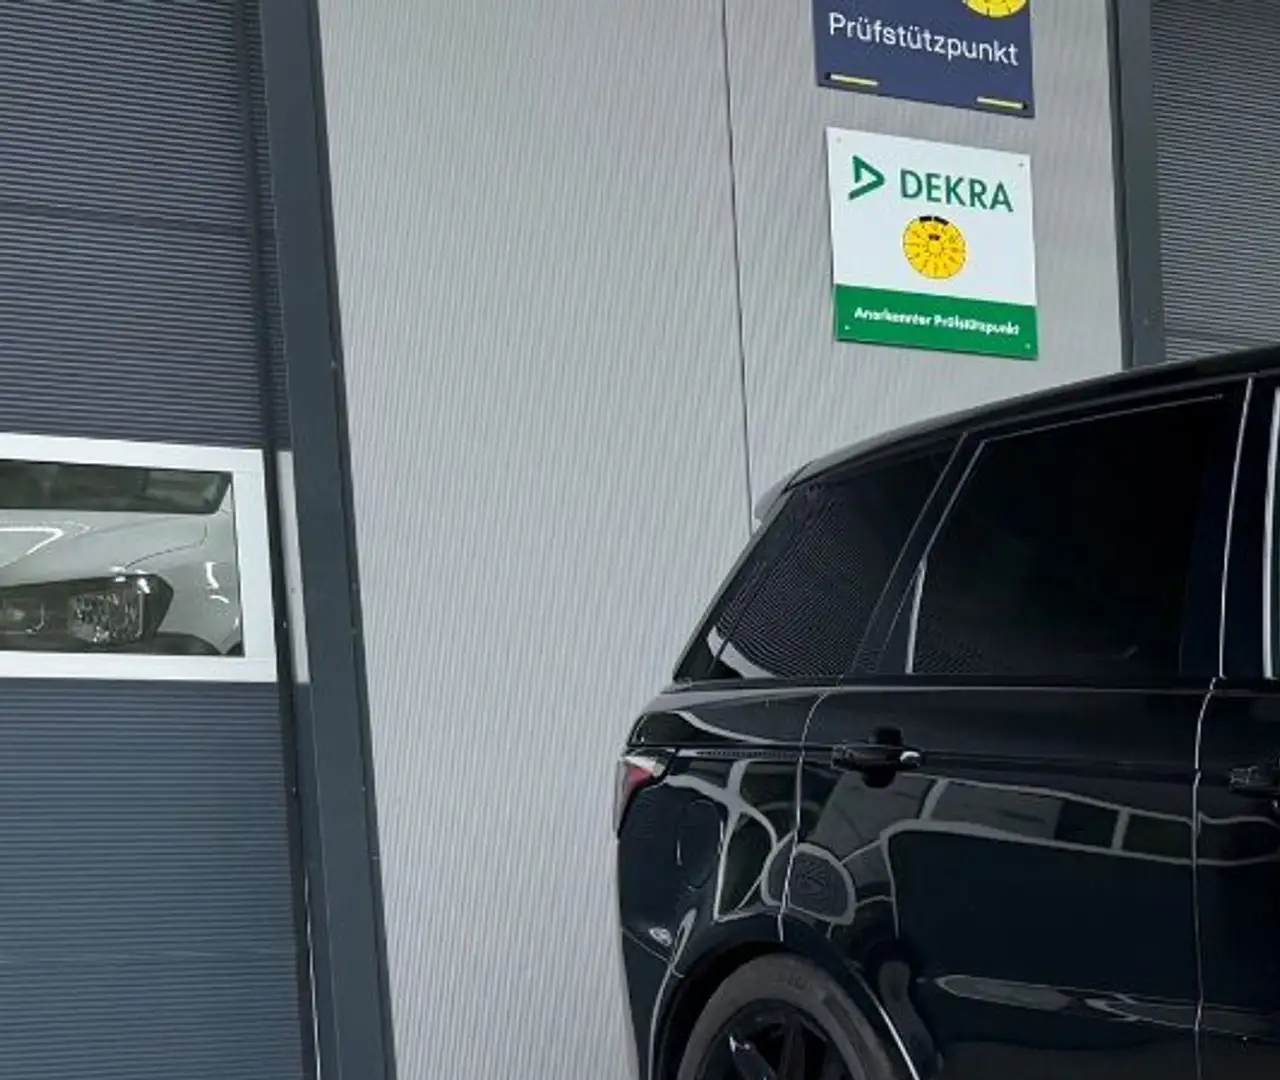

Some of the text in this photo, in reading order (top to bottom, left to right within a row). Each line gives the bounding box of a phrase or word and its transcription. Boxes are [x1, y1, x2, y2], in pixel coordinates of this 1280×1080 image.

[828, 12, 1020, 66] Prüfstützpunkt
[899, 168, 1014, 213] DEKRA
[934, 312, 1021, 335] Prüfstützpunkt
